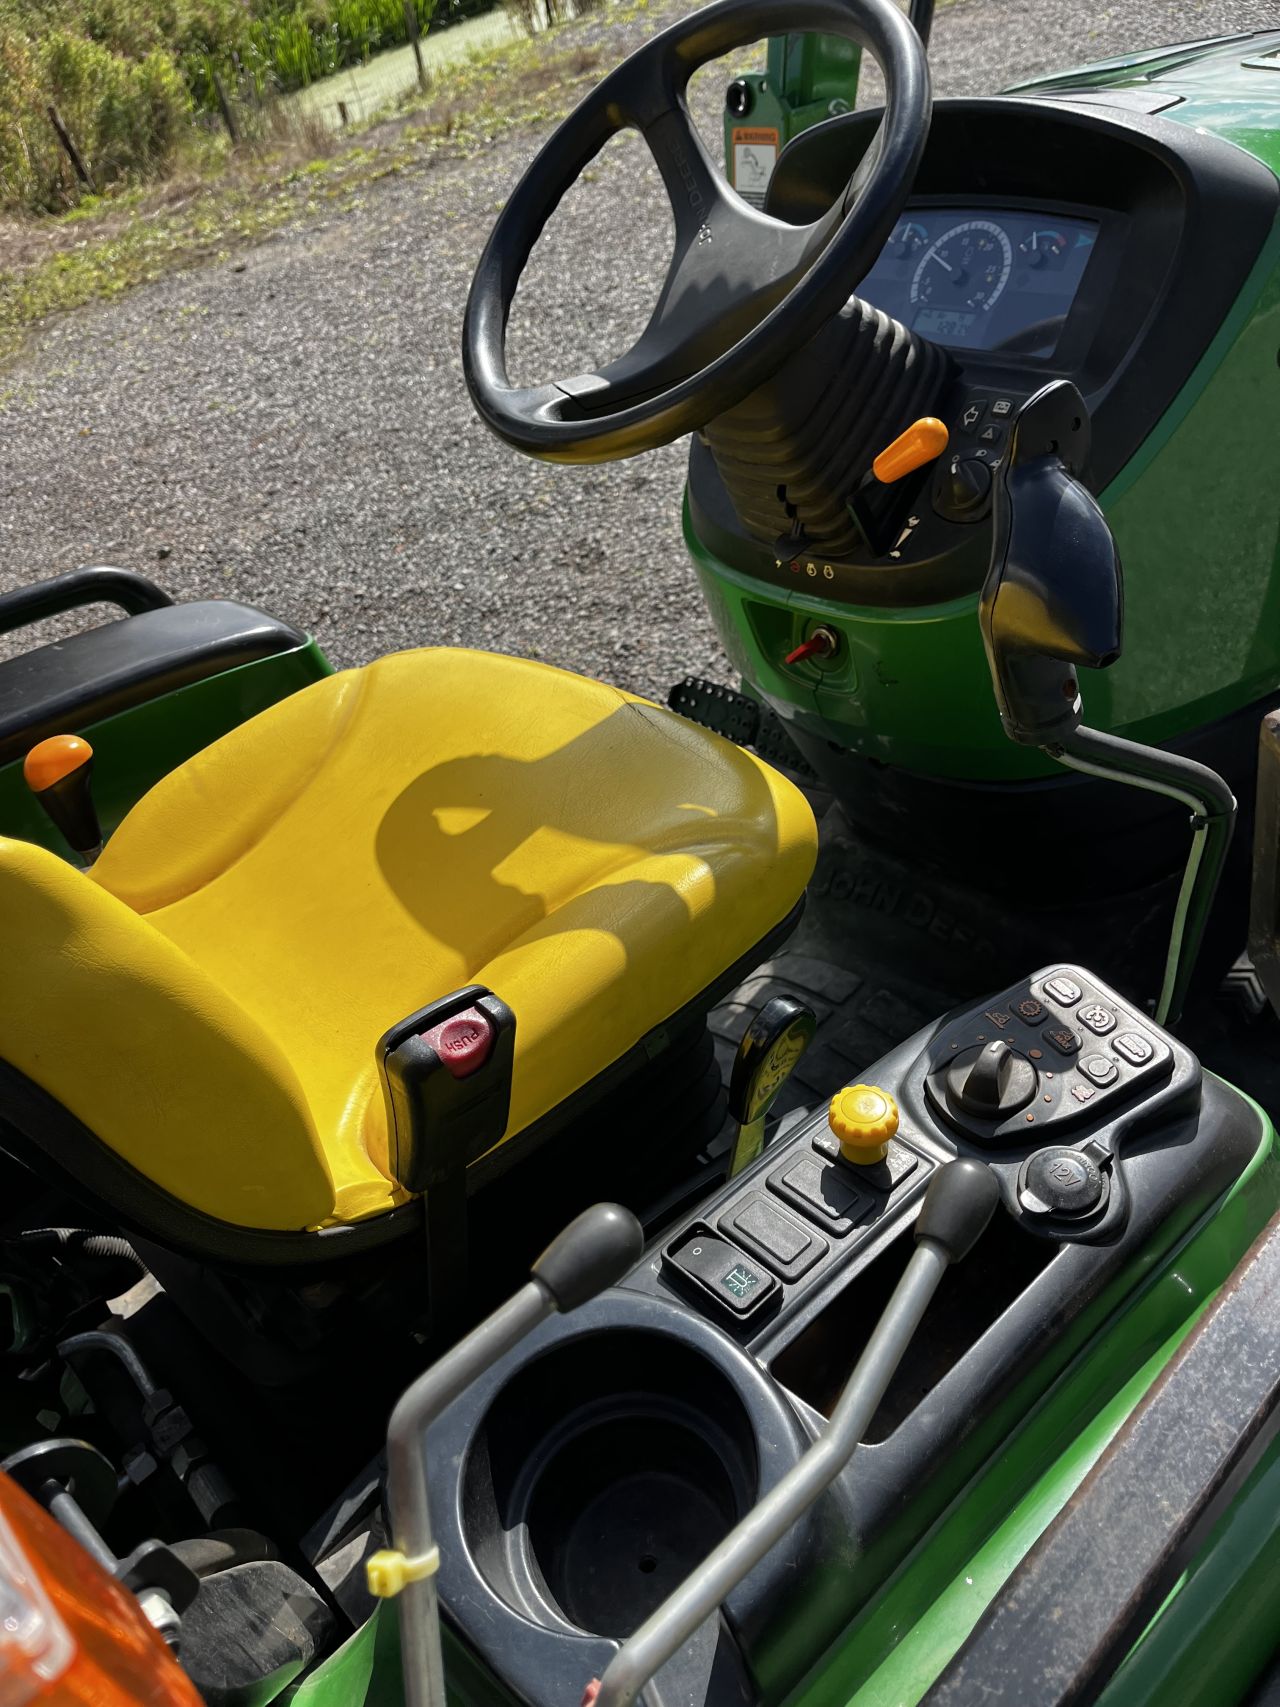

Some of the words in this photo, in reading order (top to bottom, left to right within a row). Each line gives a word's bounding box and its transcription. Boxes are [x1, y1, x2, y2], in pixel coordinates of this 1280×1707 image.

[668, 139, 704, 208] DEERE
[813, 870, 902, 917] JOHN
[445, 1027, 479, 1052] PUSH
[1049, 1163, 1081, 1187] 12V
